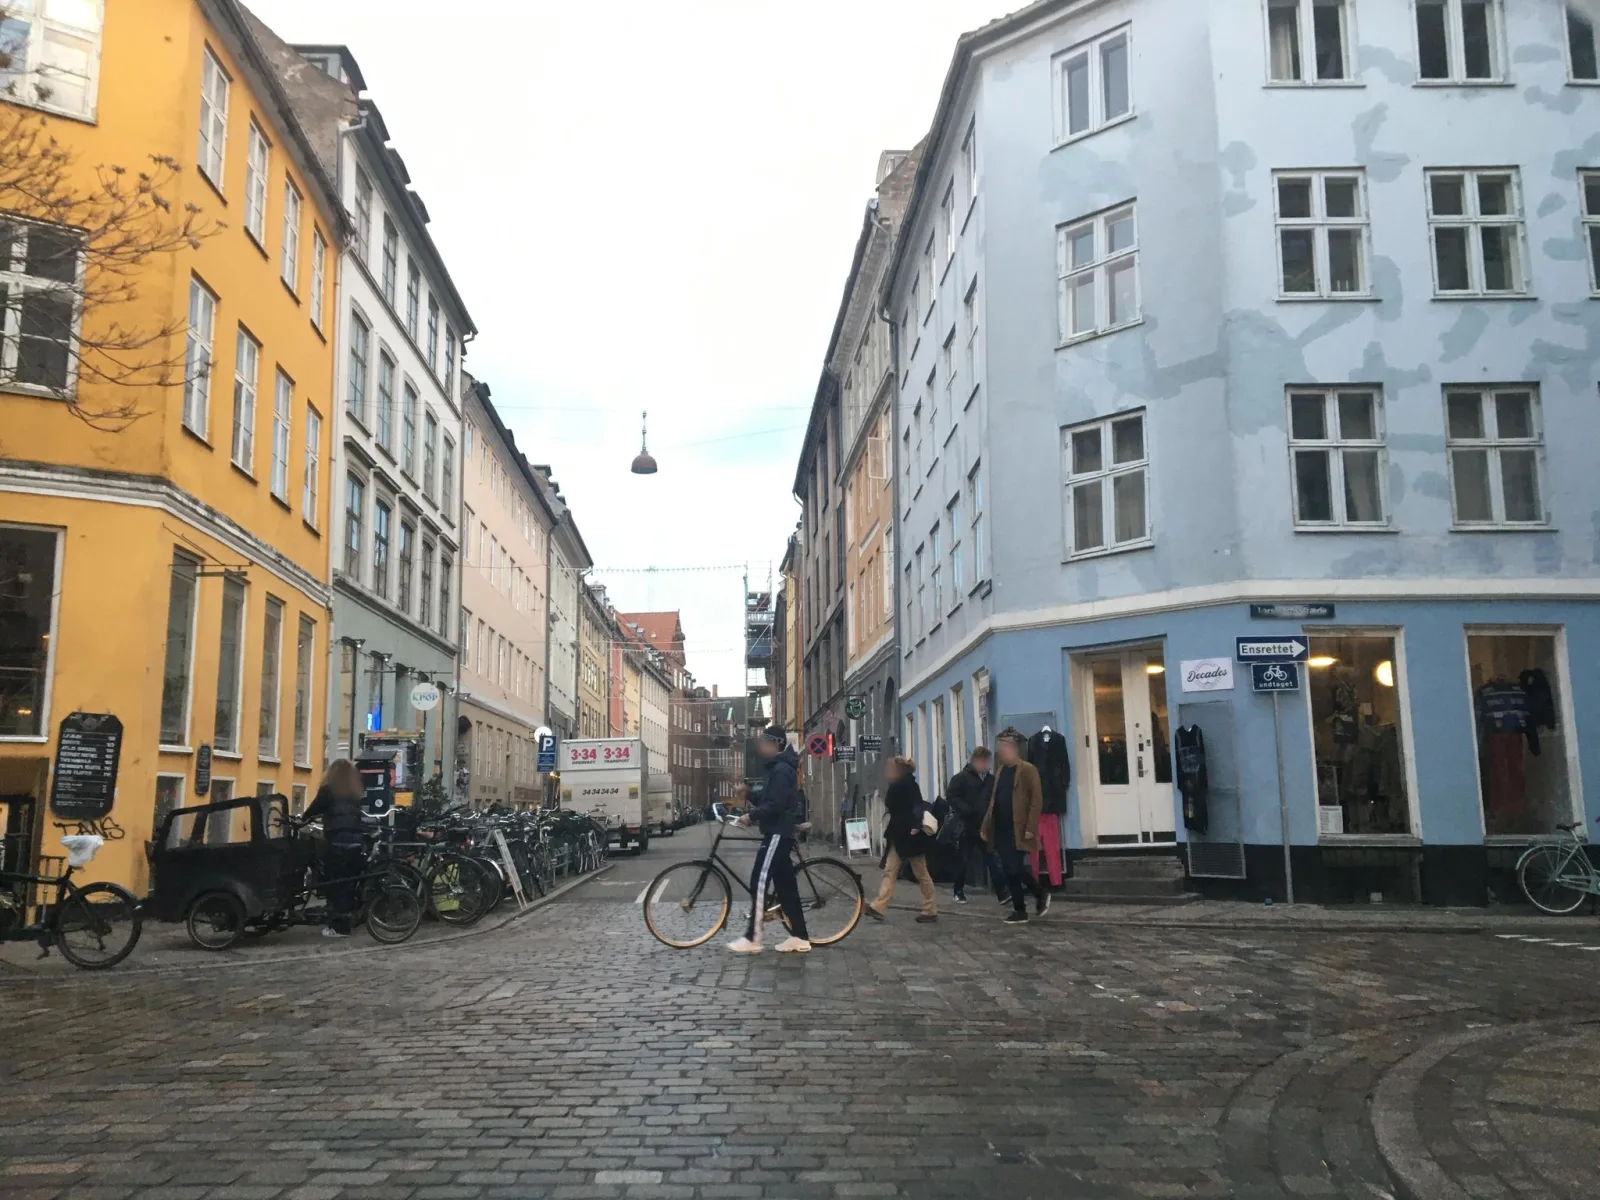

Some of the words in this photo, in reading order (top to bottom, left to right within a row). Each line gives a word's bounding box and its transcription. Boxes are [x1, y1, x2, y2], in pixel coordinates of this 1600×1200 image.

[1241, 644, 1294, 654] Ensrettet
[1186, 666, 1229, 682] Decades
[543, 737, 554, 751] P
